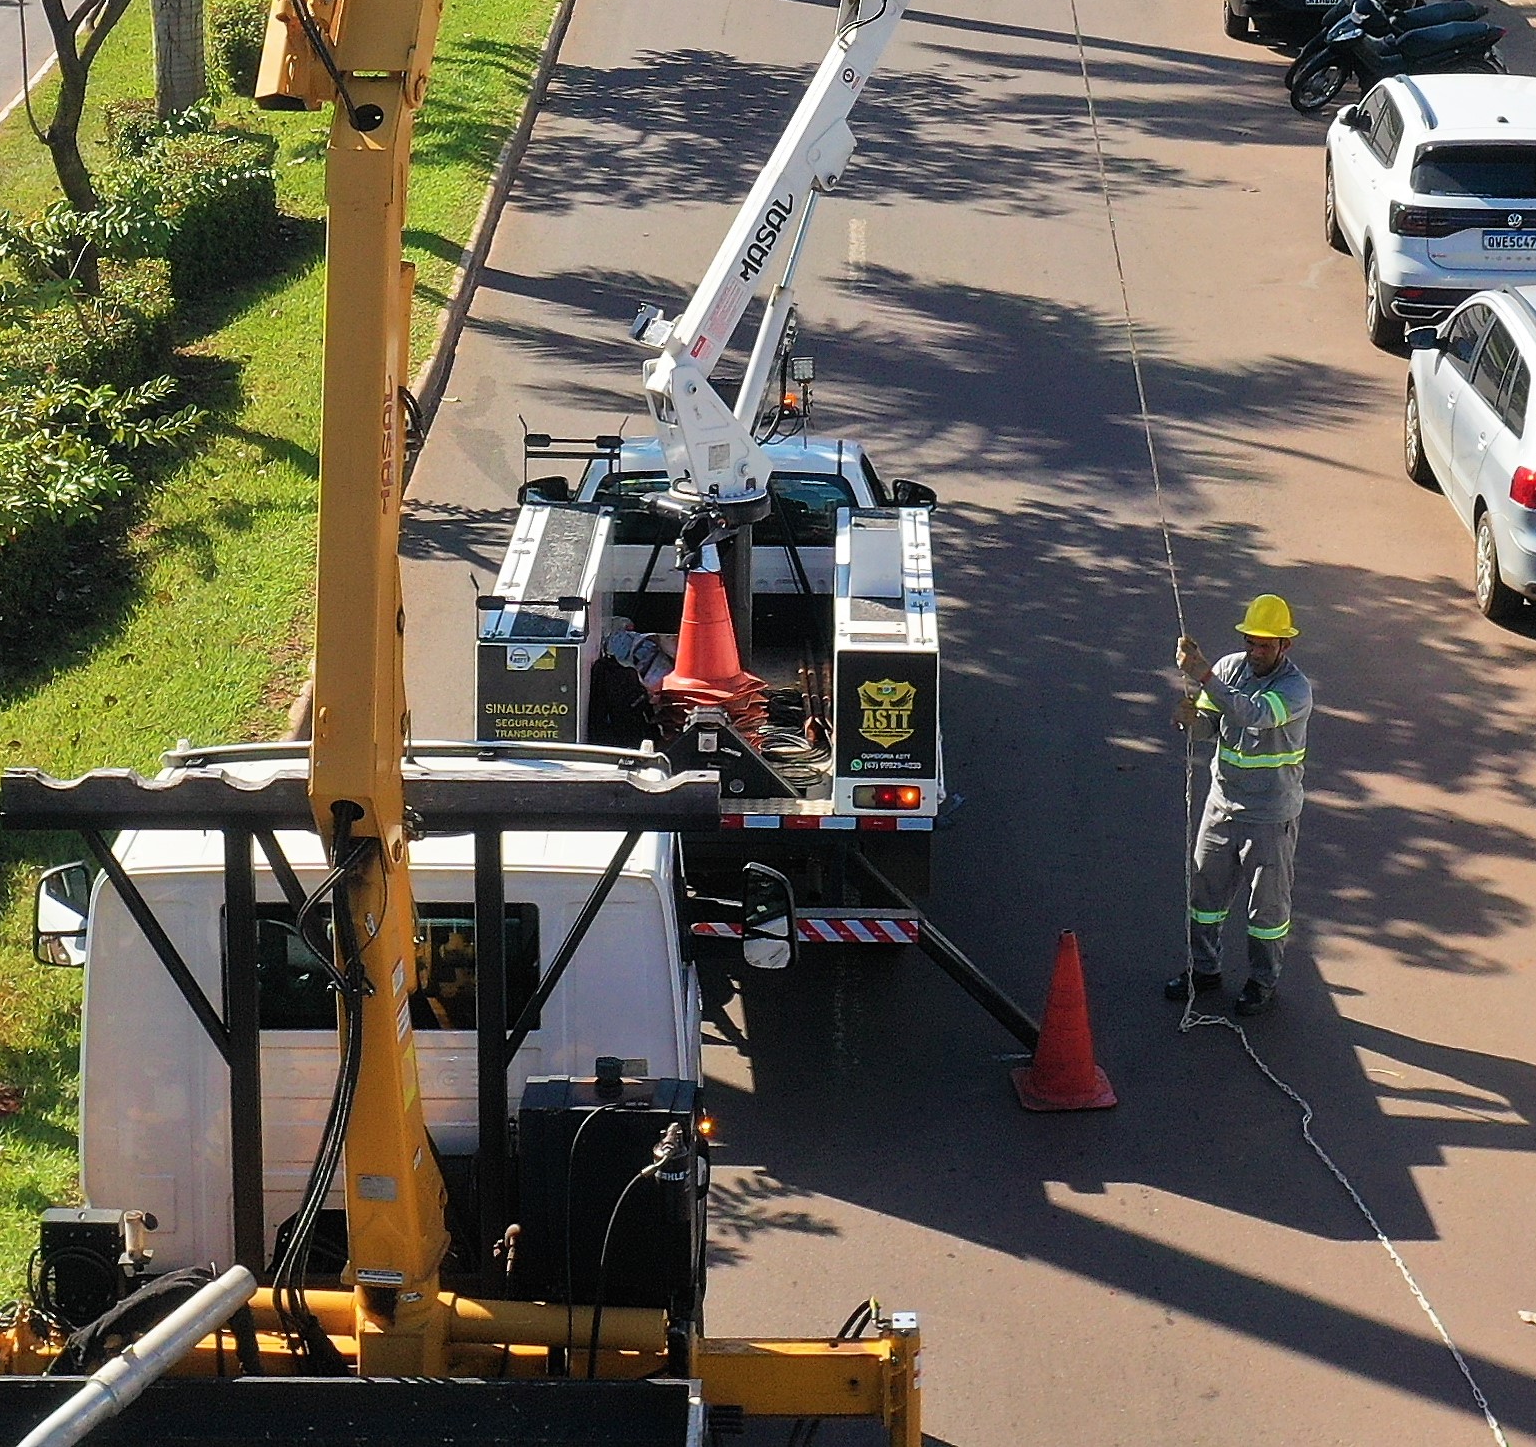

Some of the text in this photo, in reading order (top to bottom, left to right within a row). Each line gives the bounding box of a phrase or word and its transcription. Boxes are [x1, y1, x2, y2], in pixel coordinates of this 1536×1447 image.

[739, 193, 794, 282] MASAL
[484, 702, 569, 717] SINALIZAÇÃO
[863, 710, 911, 729] ASTT
[494, 729, 559, 739] TRANSPORTE
